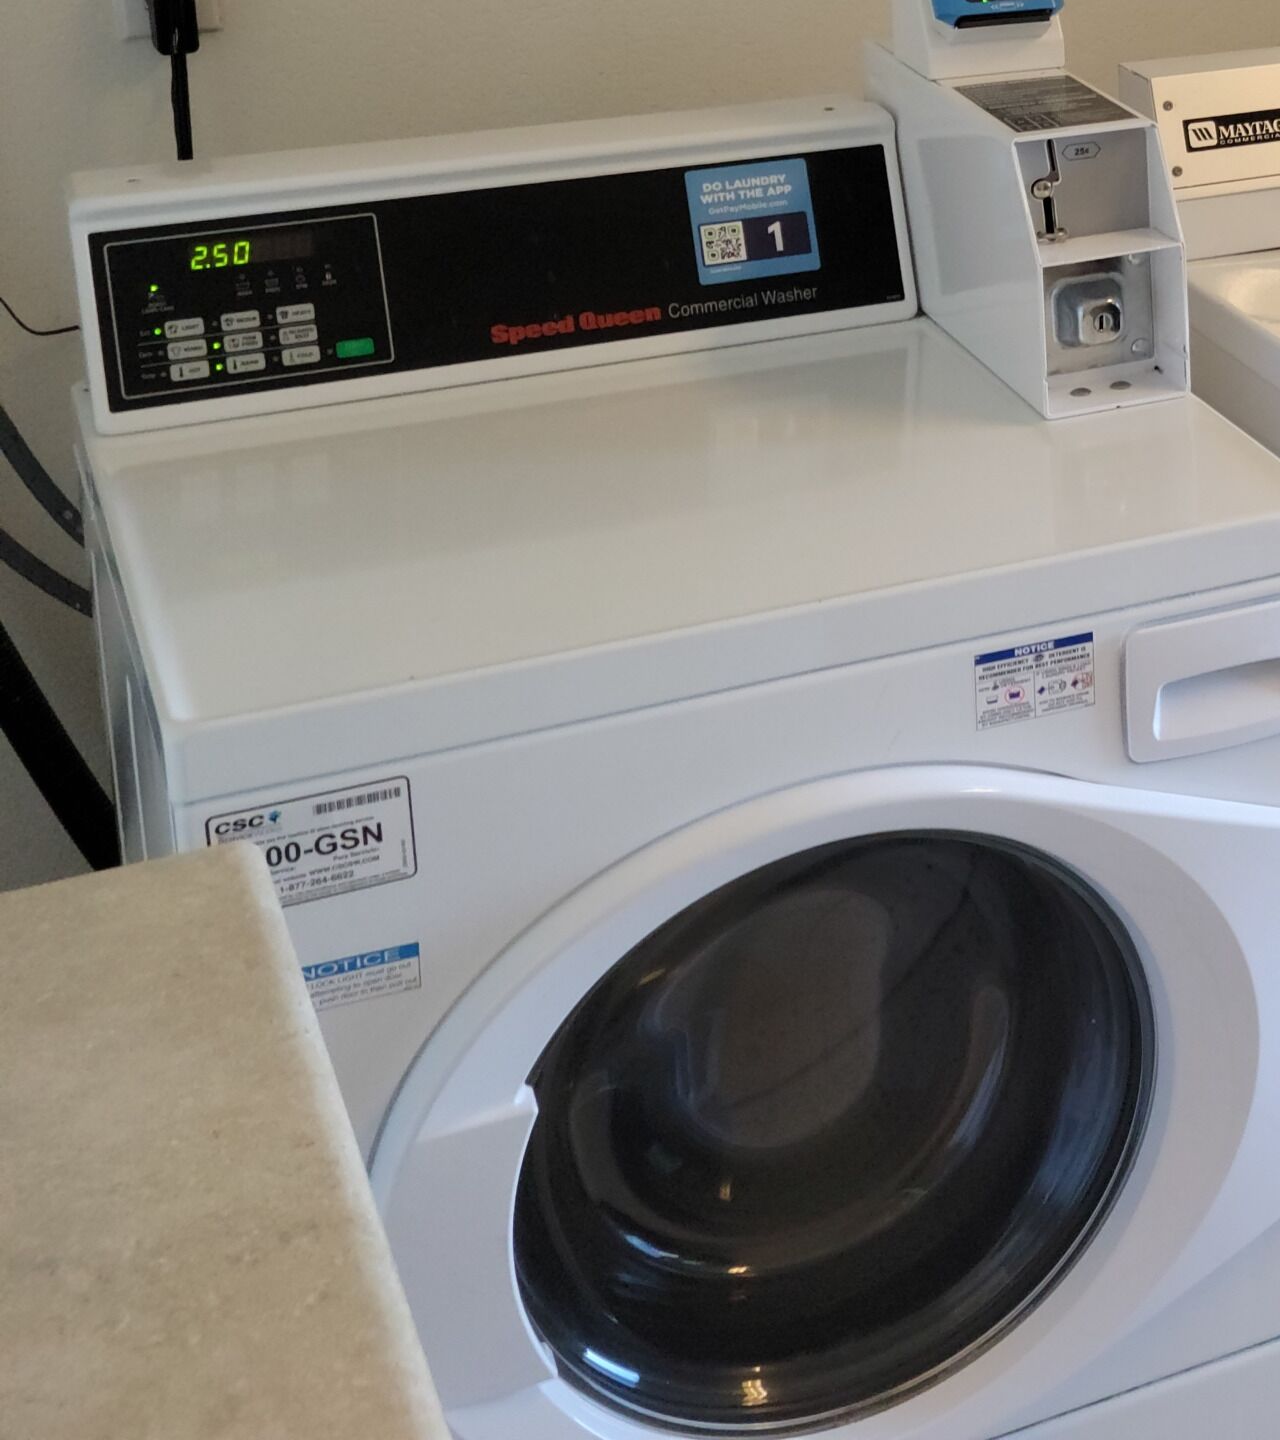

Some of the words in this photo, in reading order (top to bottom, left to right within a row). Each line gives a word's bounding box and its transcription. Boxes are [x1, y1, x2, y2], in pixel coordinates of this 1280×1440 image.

[702, 181, 722, 193] DO
[725, 173, 786, 190] LAUNDRY
[700, 191, 736, 205] WITH
[738, 187, 763, 200] THE
[767, 184, 792, 197] APP
[767, 220, 784, 253] 1
[190, 240, 250, 271] 2.50
[490, 314, 575, 345] Speed
[578, 305, 662, 329] Queen
[668, 296, 758, 320] Commercial
[761, 286, 819, 306] Washer
[1014, 640, 1055, 657] NOTICE
[215, 814, 265, 836] CSC
